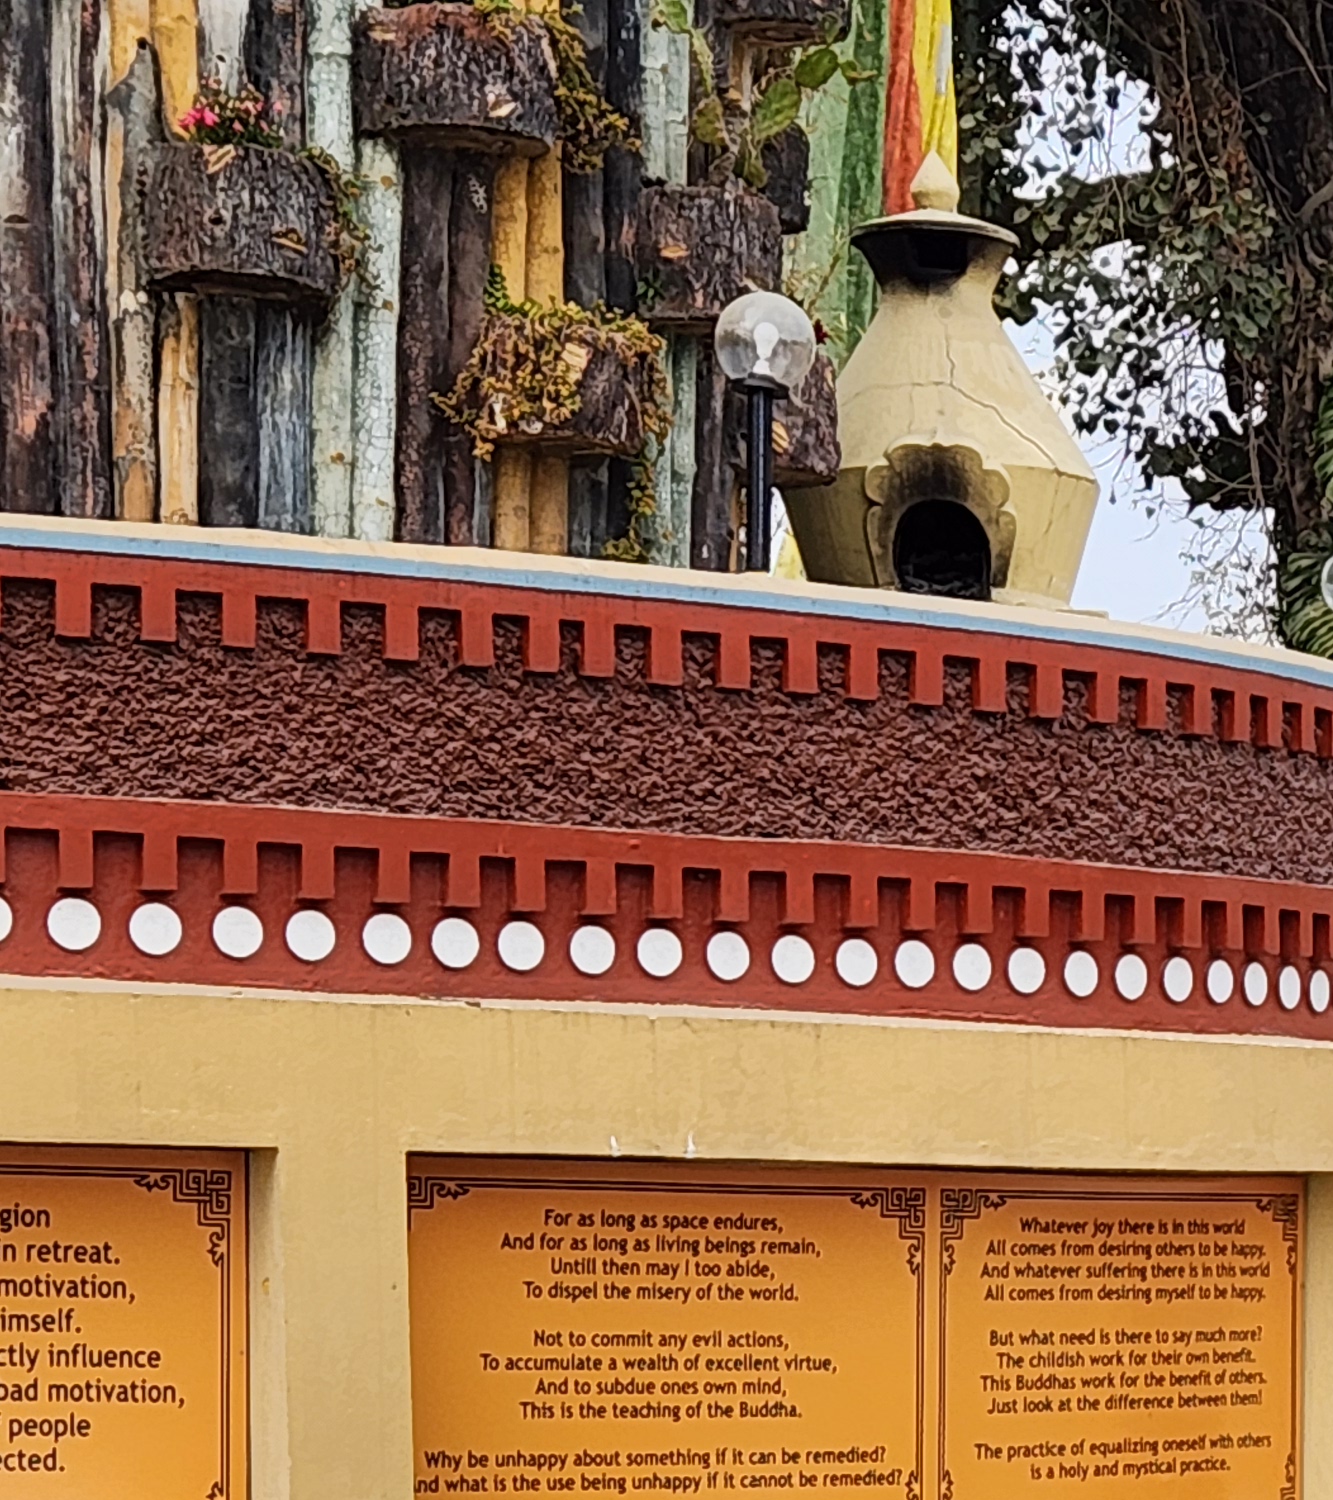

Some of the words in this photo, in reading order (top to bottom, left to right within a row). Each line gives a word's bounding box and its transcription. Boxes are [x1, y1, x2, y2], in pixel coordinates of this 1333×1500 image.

[544, 1209, 573, 1227] For
[577, 1213, 595, 1227] as
[601, 1209, 636, 1232] long
[640, 1214, 658, 1229] as
[662, 1215, 709, 1233] space
[713, 1212, 783, 1234] endures,
[1019, 1217, 1089, 1235] Whatever
[1091, 1218, 1115, 1239] joy
[1118, 1218, 1155, 1235] there
[1158, 1219, 1169, 1235] is
[1172, 1218, 1184, 1234] in
[1187, 1219, 1209, 1235] this
[26, 1240, 120, 1265] retreat.
[500, 1232, 534, 1250] And
[540, 1232, 565, 1250] for
[569, 1237, 587, 1251] as
[593, 1233, 628, 1256] long
[632, 1238, 651, 1253] as
[656, 1234, 700, 1258] living
[704, 1235, 756, 1258] beings
[760, 1237, 821, 1258] remain,
[986, 1239, 1006, 1256] All
[1010, 1243, 1056, 1256] comes
[1061, 1239, 1094, 1256] from
[1098, 1240, 1152, 1260] desiring
[1155, 1240, 1195, 1257] others
[1198, 1242, 1211, 1257] to
[1214, 1240, 1228, 1256] be
[551, 1257, 597, 1275] Untill
[602, 1257, 641, 1275] then
[645, 1262, 680, 1281] may
[685, 1258, 690, 1277] I
[694, 1261, 722, 1277] too
[726, 1259, 775, 1281] abide,
[980, 1261, 1010, 1279] And
[1013, 1261, 1082, 1279] whatever
[1086, 1262, 1147, 1283] suffering
[1150, 1262, 1185, 1279] there
[1189, 1262, 1199, 1278] is
[1202, 1262, 1213, 1278] in
[1216, 1262, 1237, 1278] this
[0, 1273, 135, 1304] motivation,
[522, 1281, 543, 1298] To
[547, 1281, 598, 1303] dispel
[603, 1281, 632, 1300] the
[636, 1282, 691, 1305] misery
[695, 1282, 714, 1301] of
[717, 1283, 744, 1301] the
[749, 1283, 799, 1301] world.
[984, 1284, 1004, 1301] All
[1008, 1288, 1055, 1301] comes
[1059, 1283, 1093, 1301] from
[1097, 1283, 1152, 1304] desiring
[1155, 1283, 1196, 1304] myself
[1198, 1285, 1211, 1300] to
[1214, 1283, 1228, 1300] be
[534, 1329, 563, 1348] Not
[568, 1331, 586, 1348] to
[591, 1329, 653, 1348] commit
[658, 1334, 688, 1352] any
[692, 1330, 722, 1348] evil
[727, 1330, 789, 1351] actions,
[989, 1329, 1014, 1347] But
[1019, 1329, 1055, 1346] what
[1059, 1328, 1095, 1345] need
[1100, 1328, 1111, 1345] is
[1115, 1328, 1152, 1345] there
[1155, 1329, 1169, 1344] to
[1195, 1327, 1226, 1343] much
[1229, 1325, 1262, 1342] more?
[47, 1342, 161, 1369] influence
[479, 1353, 500, 1371] To
[504, 1353, 603, 1371] accumulate
[608, 1357, 618, 1371] a
[622, 1353, 679, 1372] wealth
[683, 1353, 701, 1371] of
[705, 1353, 780, 1372] excellent
[784, 1353, 837, 1374] virtue,
[996, 1352, 1025, 1369] The
[1029, 1351, 1085, 1368] childish
[1089, 1350, 1125, 1367] work
[1128, 1349, 1147, 1366] for
[1151, 1349, 1183, 1366] their
[535, 1376, 568, 1395] And
[574, 1379, 591, 1395] to
[596, 1377, 656, 1395] subdue
[660, 1381, 699, 1395] ones
[703, 1381, 737, 1395] own
[742, 1376, 786, 1398] mind,
[980, 1374, 1011, 1392] This
[1016, 1373, 1076, 1391] Buddhas
[1080, 1372, 1116, 1389] work
[1120, 1371, 1140, 1388] for
[1144, 1371, 1166, 1388] the
[1169, 1370, 1212, 1387] benefit
[1214, 1369, 1227, 1386] of
[48, 1378, 185, 1409] motivation,
[987, 1397, 1018, 1415] Just
[1023, 1395, 1054, 1413] look
[1058, 1397, 1072, 1412] at
[1077, 1395, 1100, 1411] the
[1105, 1393, 1174, 1411] difference
[1178, 1391, 1227, 1408] between
[1230, 1389, 1262, 1406] them!
[518, 1401, 555, 1420] This
[560, 1401, 574, 1419] is
[579, 1400, 607, 1419] the
[612, 1401, 681, 1423] teaching
[685, 1400, 703, 1419] of
[707, 1400, 734, 1419] the
[739, 1400, 802, 1418] Buddha.
[9, 1412, 91, 1444] people
[424, 1450, 463, 1473] Why
[468, 1450, 489, 1468] be
[495, 1449, 568, 1472] unhappy
[573, 1449, 622, 1467] about
[626, 1448, 711, 1469] something
[715, 1447, 728, 1465] if
[732, 1448, 744, 1465] it
[749, 1452, 776, 1465] can
[781, 1447, 801, 1464] be
[806, 1446, 886, 1464] remedied?
[974, 1443, 1003, 1460] The
[1007, 1441, 1066, 1463] practice
[1070, 1438, 1086, 1456] of
[1089, 1437, 1159, 1459] equalizing
[1162, 1434, 1207, 1452] oneself
[1030, 1463, 1042, 1480] is
[1046, 1466, 1055, 1479] a
[1059, 1461, 1089, 1482] holy
[1093, 1460, 1119, 1477] and
[1122, 1457, 1176, 1479] mystical
[1180, 1456, 1230, 1477] practice.
[415, 1474, 439, 1493] nd
[444, 1474, 488, 1492] what
[493, 1474, 507, 1492] is
[512, 1473, 541, 1492] the
[546, 1477, 576, 1491] use
[580, 1472, 627, 1495] being
[631, 1472, 702, 1494] unhappy
[707, 1471, 719, 1489] if
[723, 1471, 736, 1489] it
[740, 1472, 794, 1488] cannot
[799, 1470, 818, 1487] be
[822, 1468, 902, 1486] remedied?
